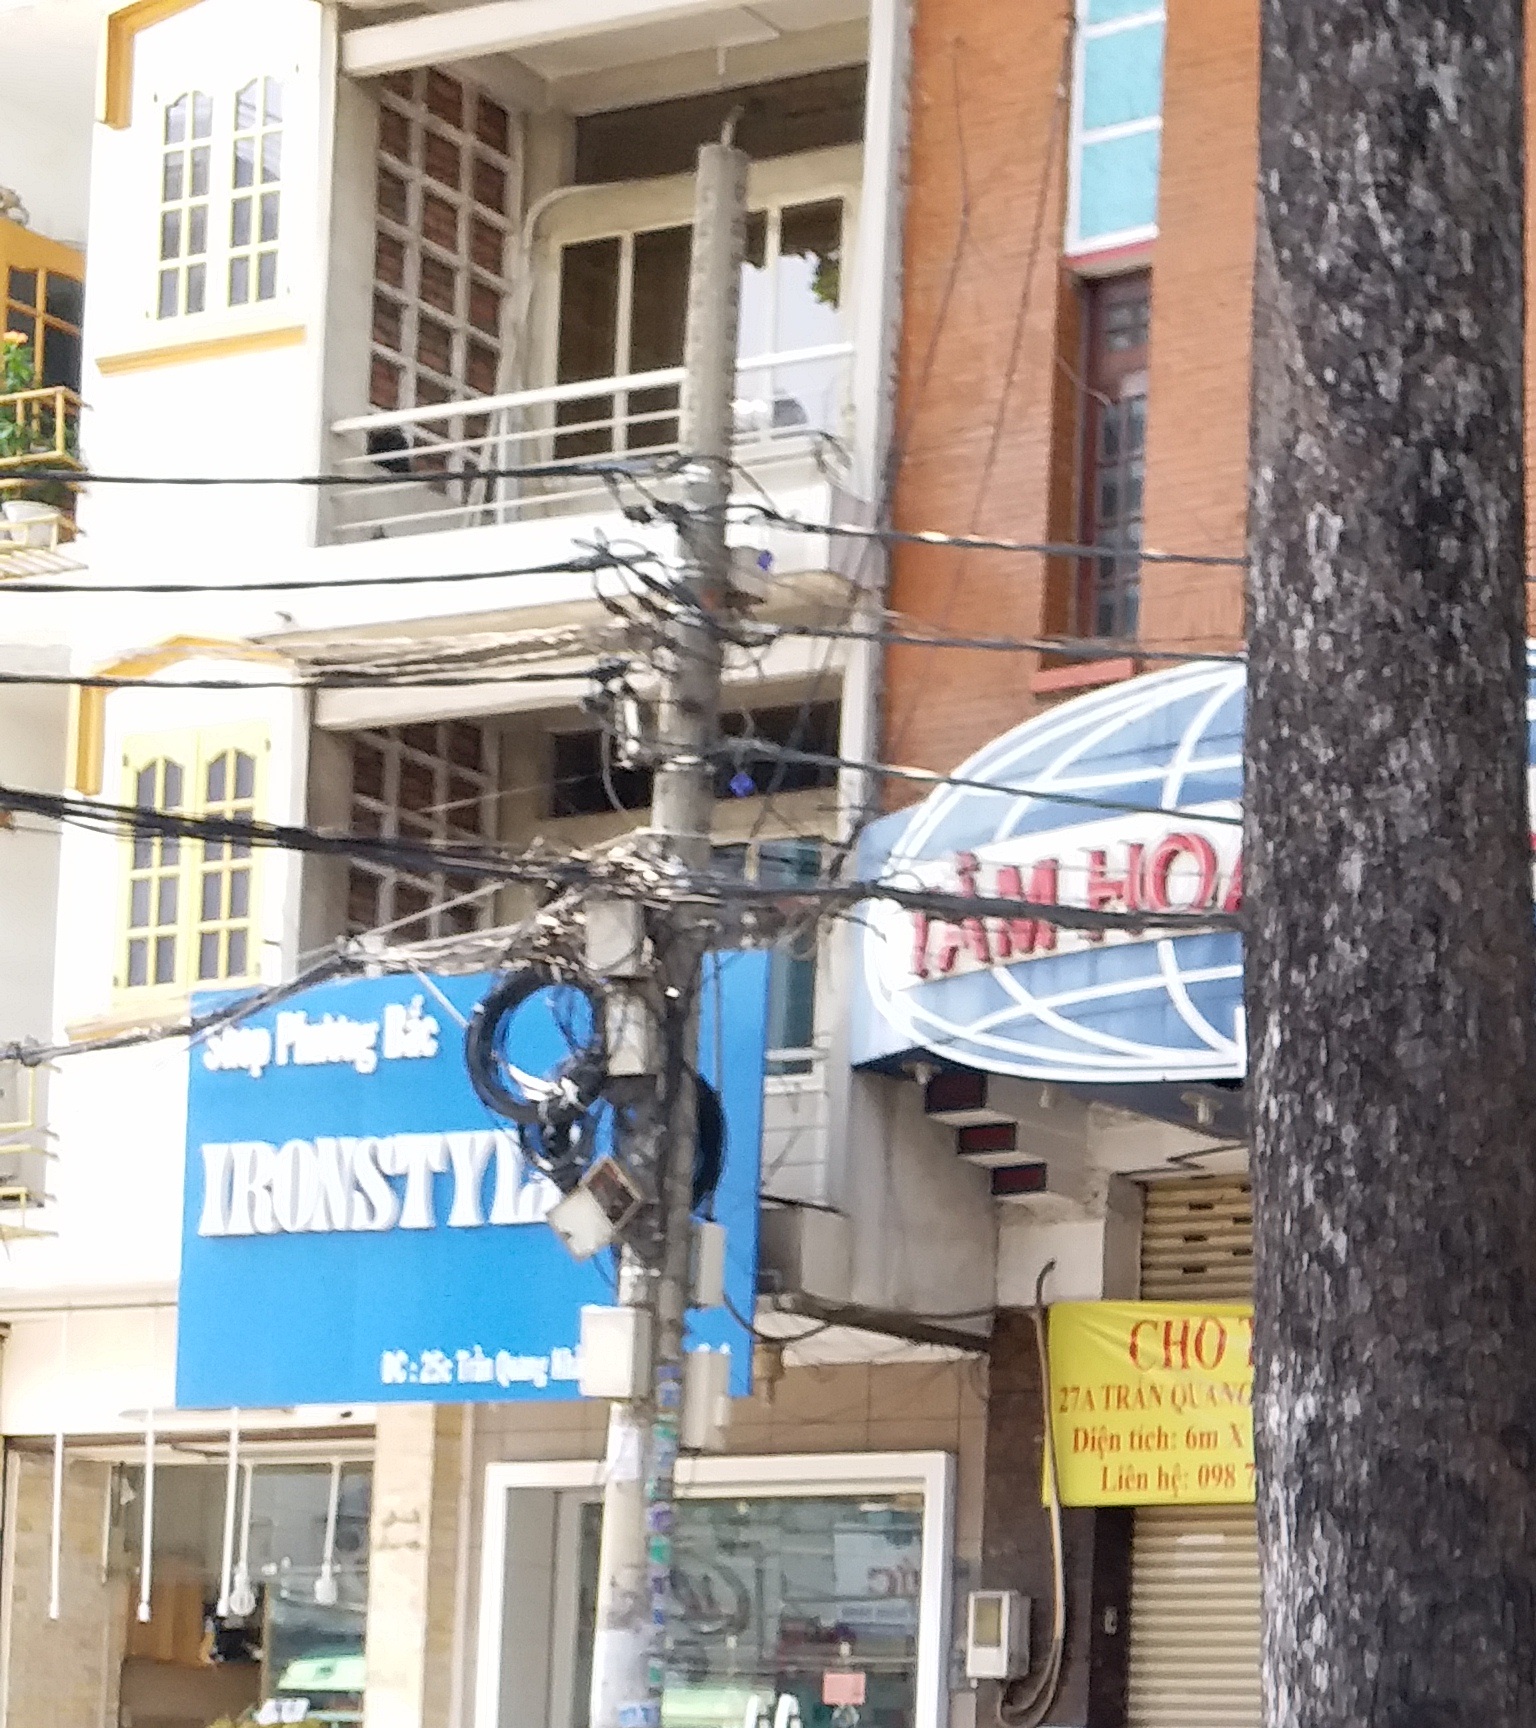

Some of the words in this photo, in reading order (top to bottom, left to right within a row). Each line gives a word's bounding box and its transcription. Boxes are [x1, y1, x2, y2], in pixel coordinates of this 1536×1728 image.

[1083, 832, 1243, 942] HO
[198, 1128, 563, 1237] IRONSTYL
[1128, 1316, 1228, 1372] CHO
[1073, 1423, 1122, 1460] Diện
[1101, 1462, 1149, 1492] Liên
[1197, 1464, 1237, 1490] 098
